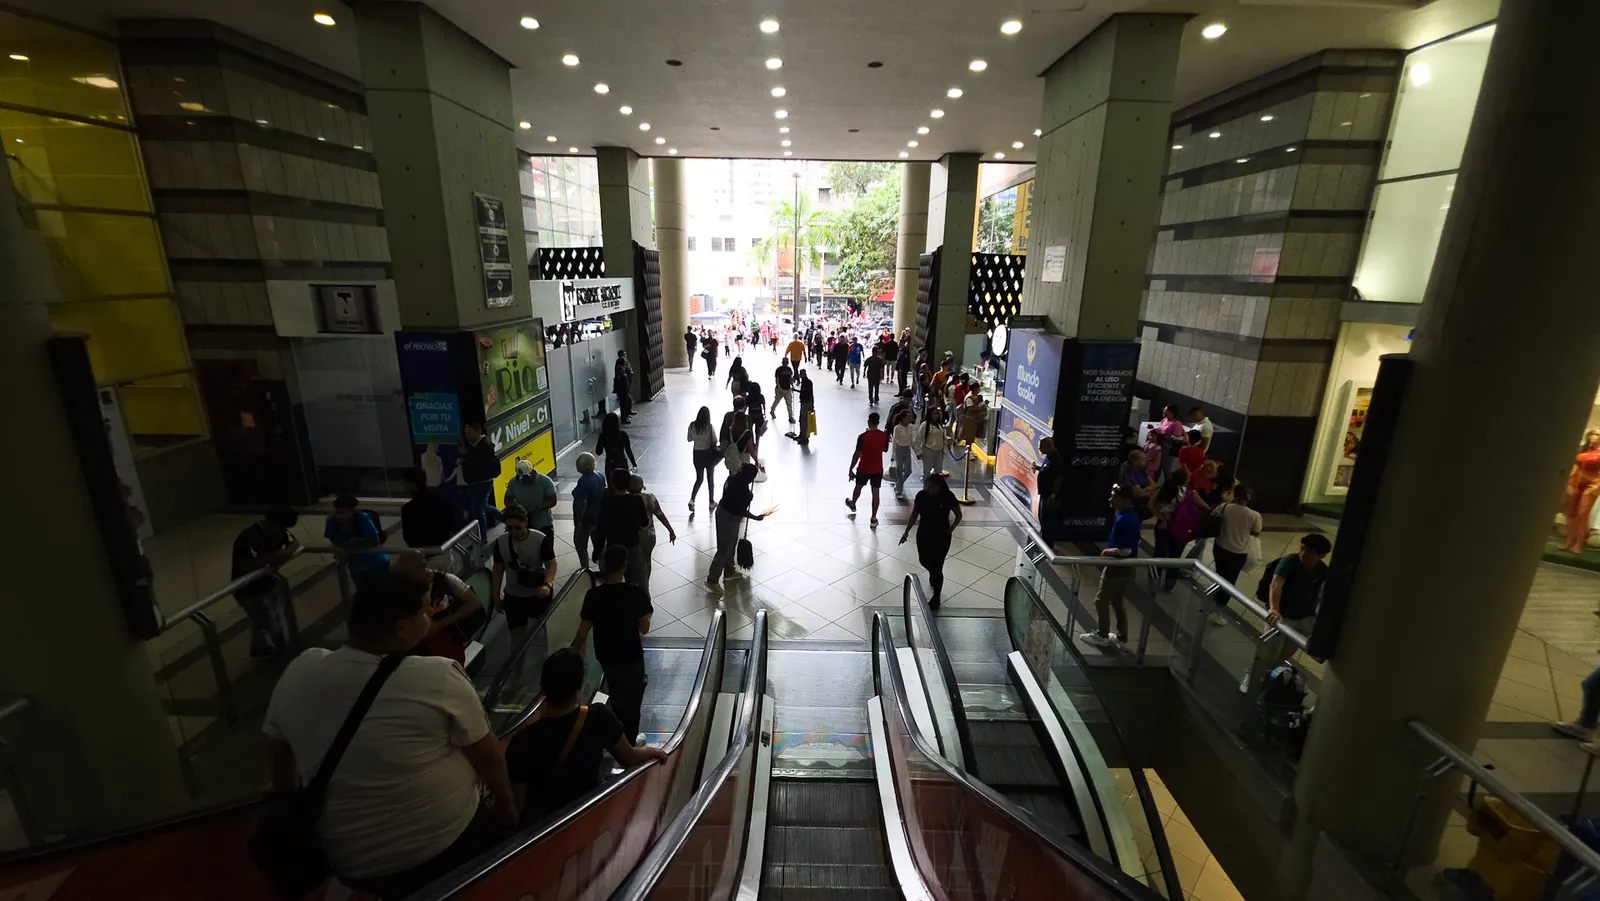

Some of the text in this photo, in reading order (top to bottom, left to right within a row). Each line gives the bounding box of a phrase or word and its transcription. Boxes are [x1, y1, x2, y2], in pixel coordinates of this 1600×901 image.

[1017, 364, 1040, 388] Mundo
[1017, 381, 1037, 404] Escolar
[416, 402, 453, 411] GRACIAS
[421, 413, 451, 421] POR TU
[505, 414, 530, 442] Nivel
[537, 404, 550, 424] C1
[423, 424, 449, 433] VISITA
